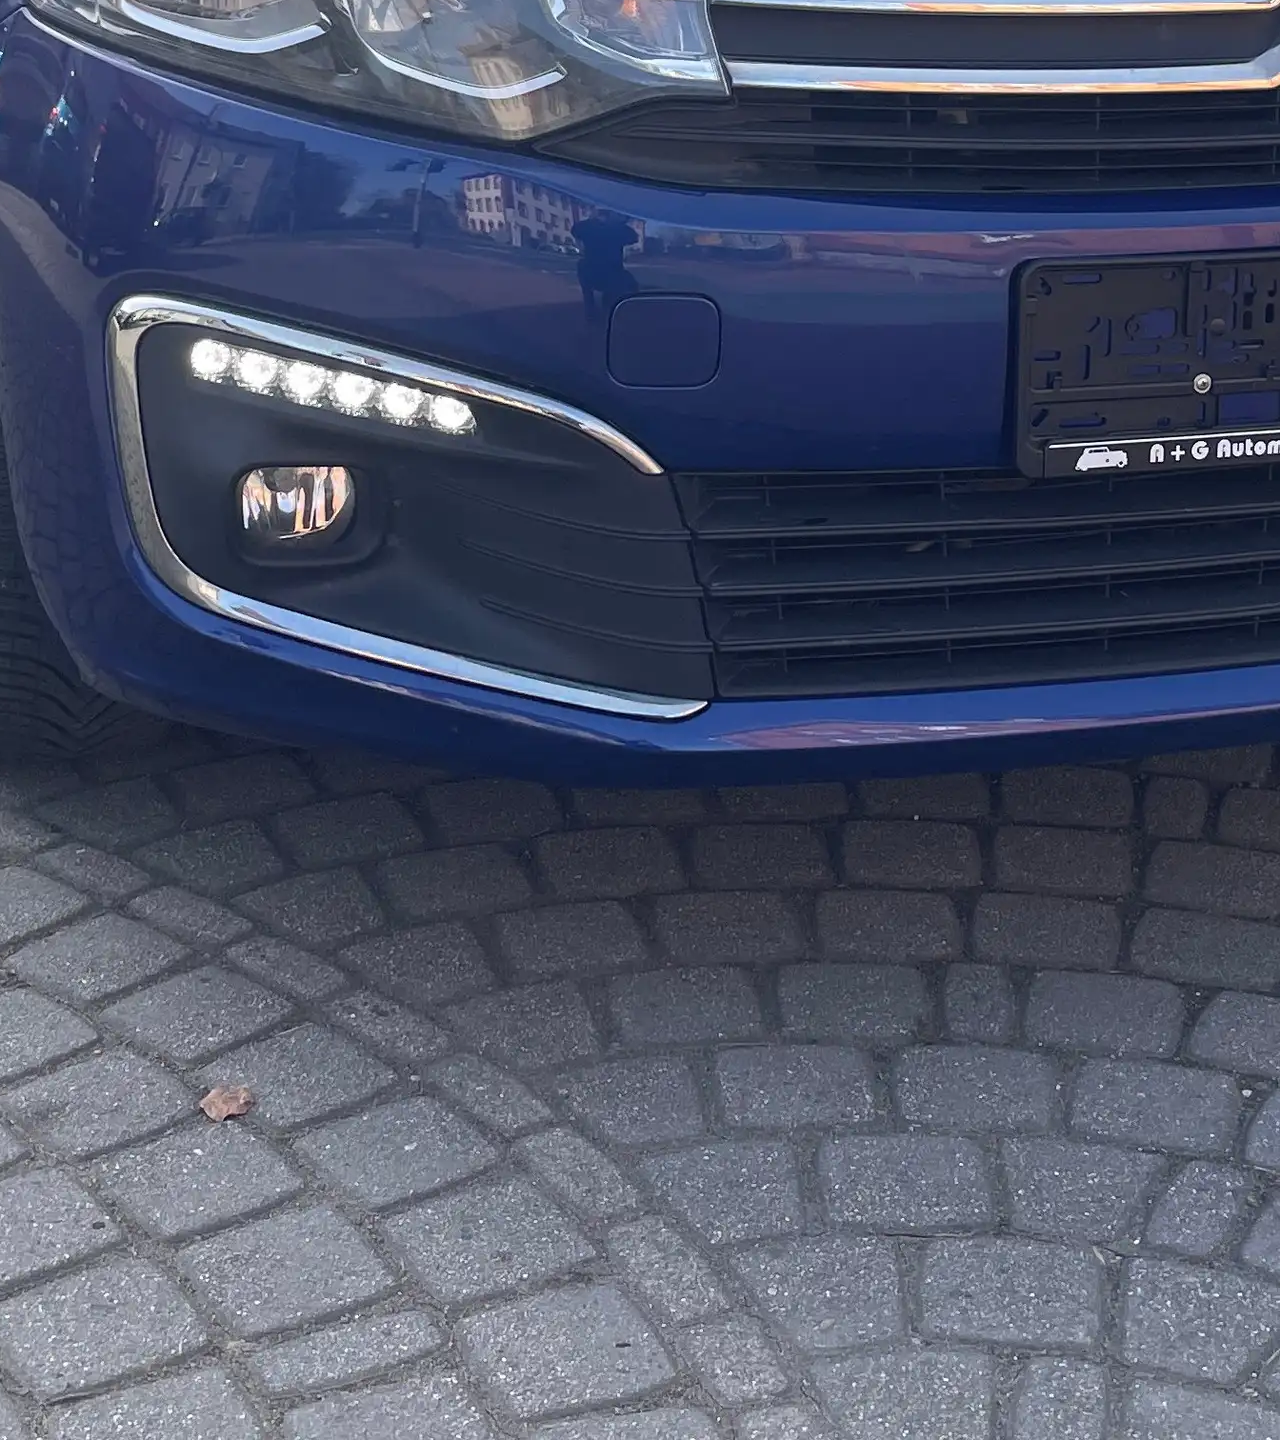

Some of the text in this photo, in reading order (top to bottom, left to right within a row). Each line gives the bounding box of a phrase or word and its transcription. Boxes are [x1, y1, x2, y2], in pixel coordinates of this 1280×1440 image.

[1149, 443, 1165, 463] A
[1170, 445, 1186, 461] +
[1191, 440, 1210, 460] G
